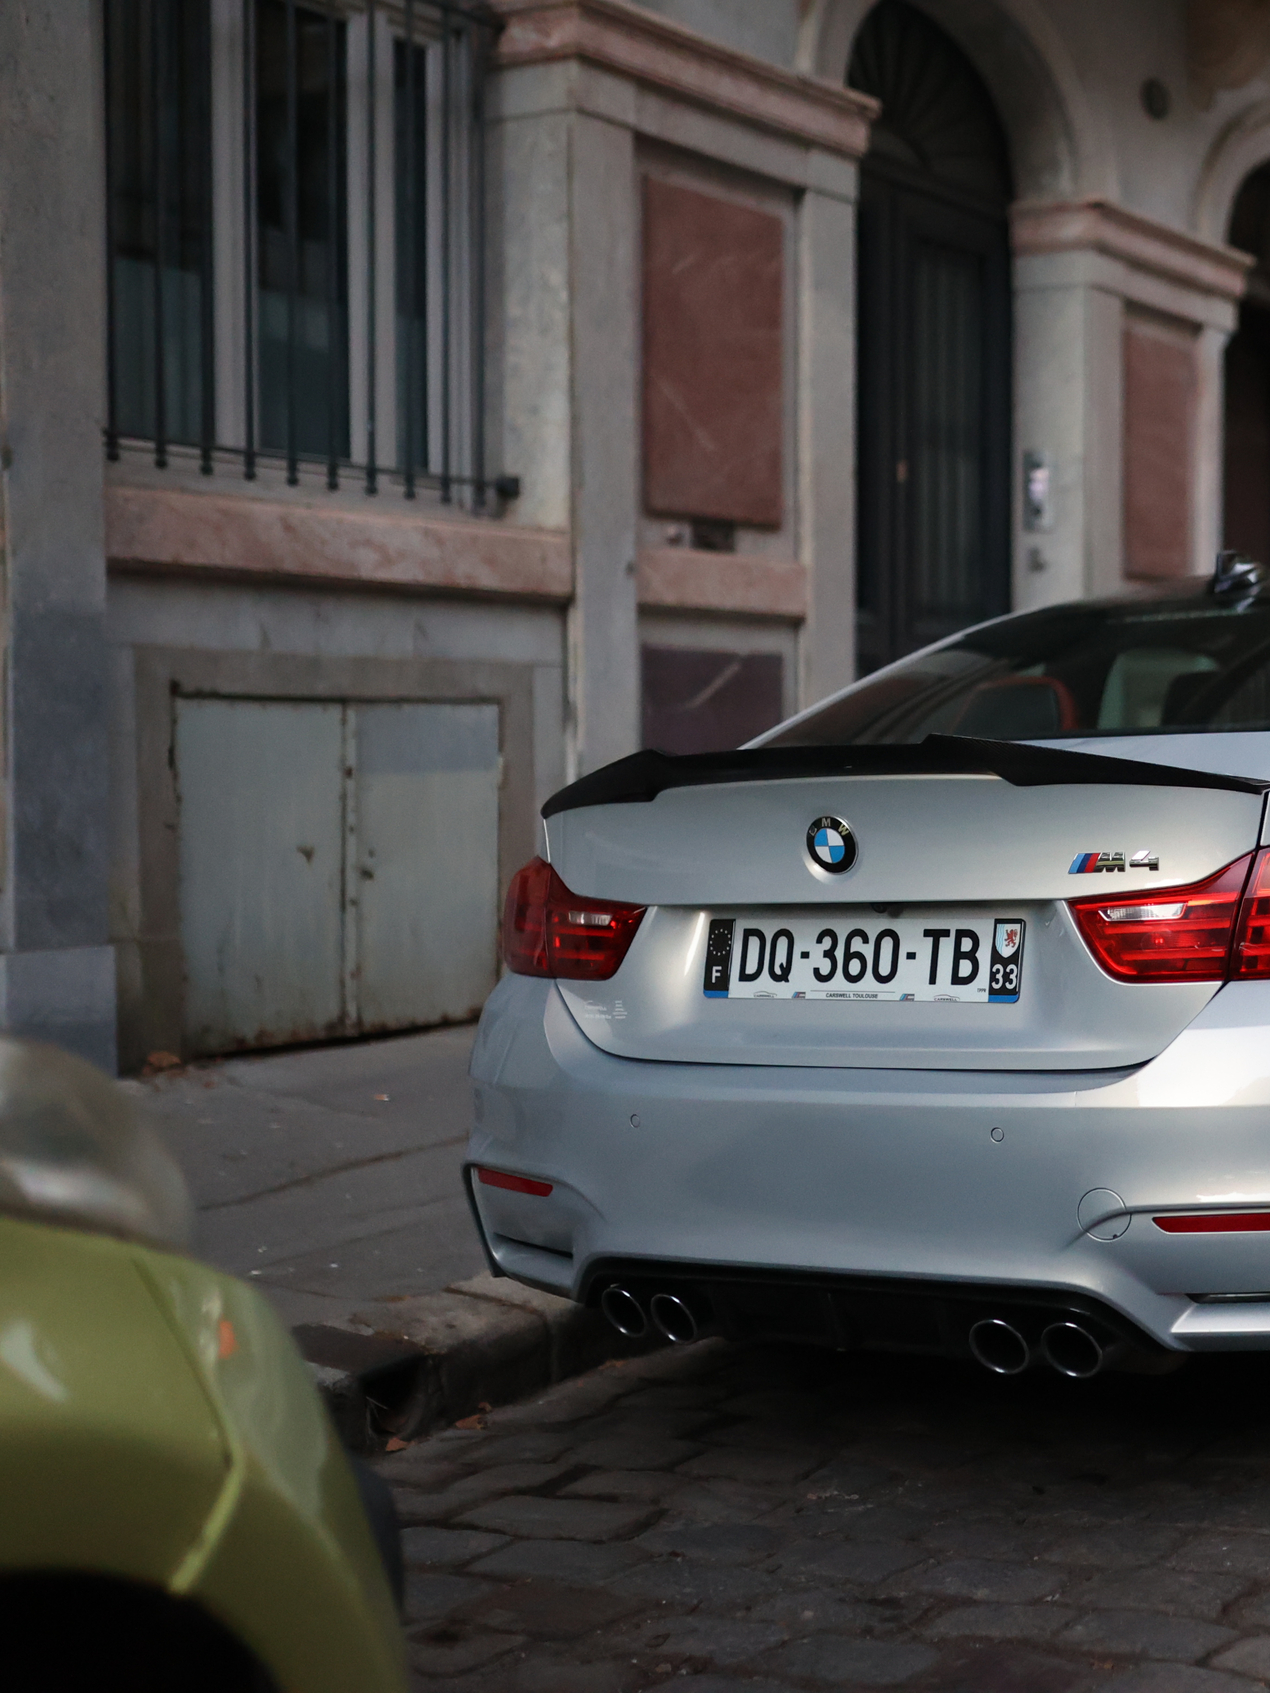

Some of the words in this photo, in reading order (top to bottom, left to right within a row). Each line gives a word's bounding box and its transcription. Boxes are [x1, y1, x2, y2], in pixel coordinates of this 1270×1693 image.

[738, 928, 981, 986] DQ-360-TB
[711, 965, 722, 983] F
[991, 964, 1018, 990] 33
